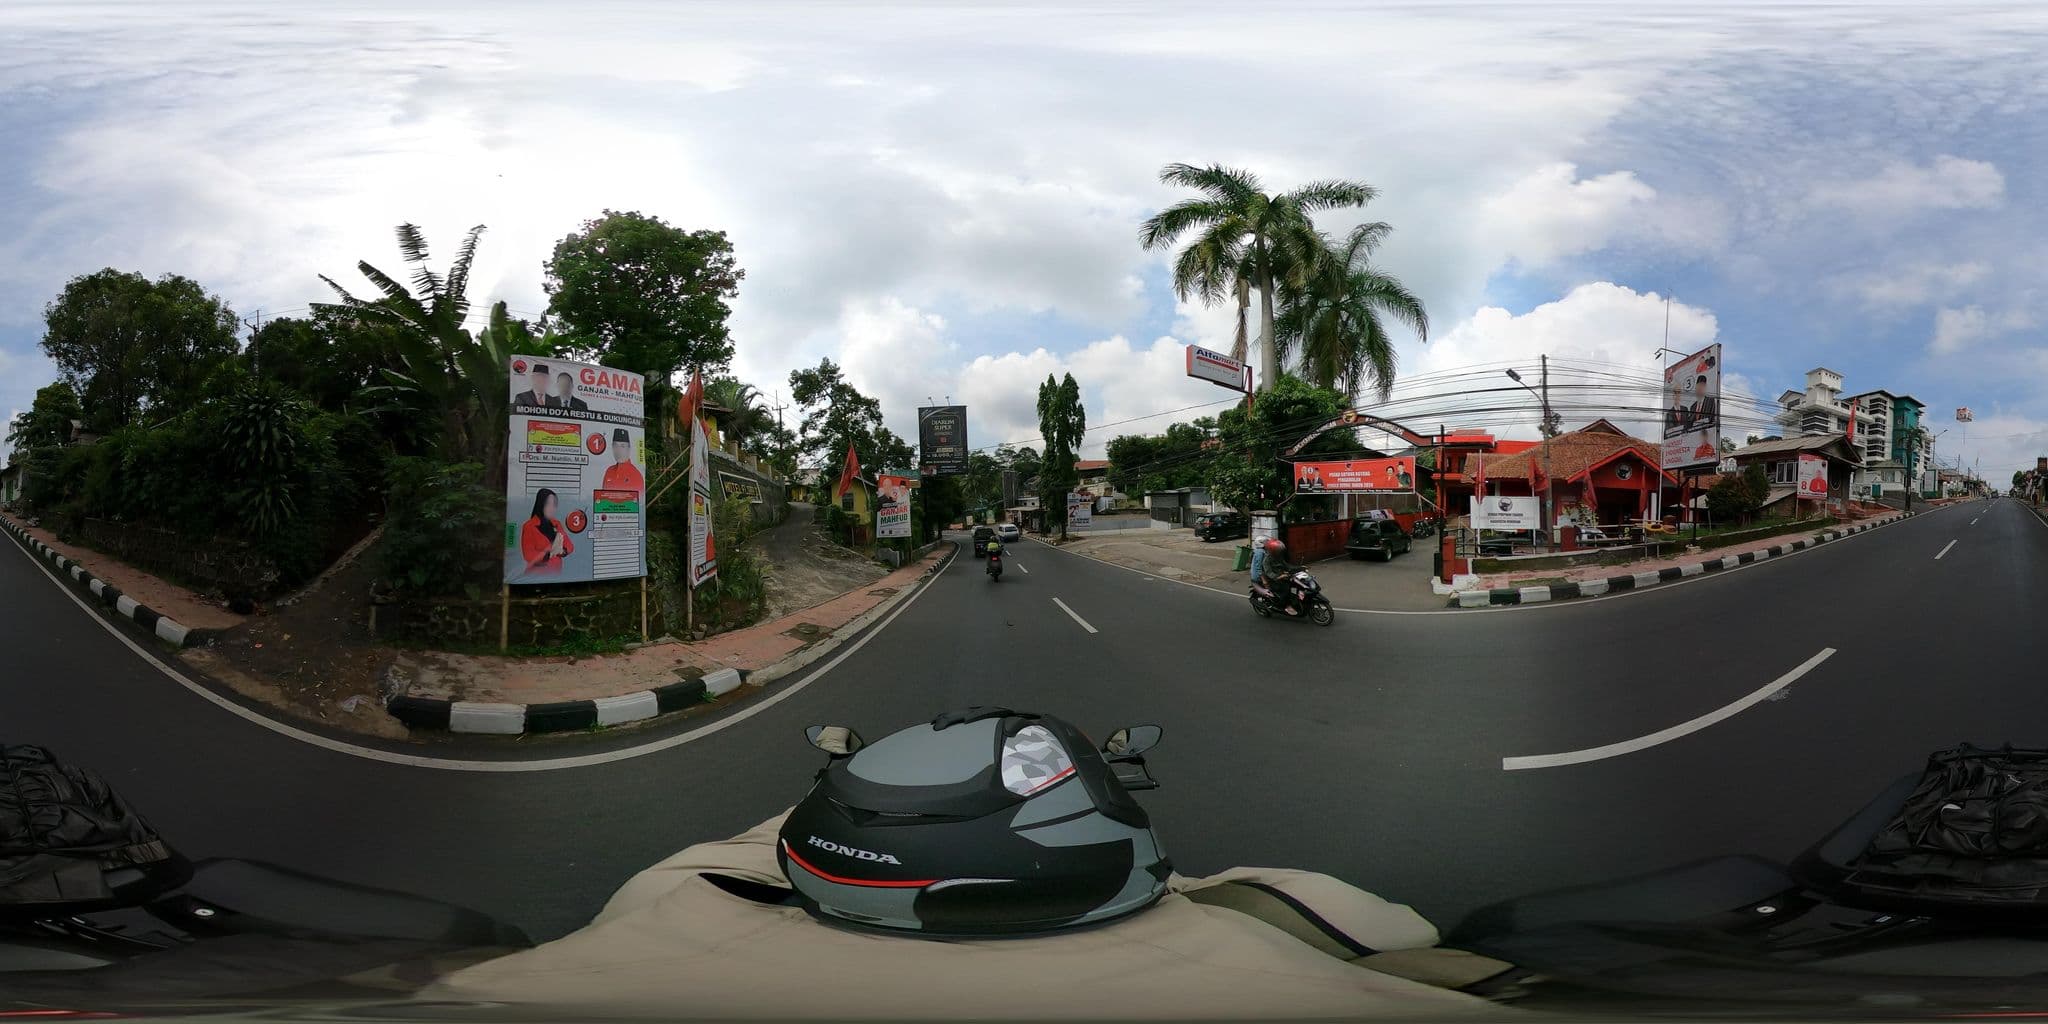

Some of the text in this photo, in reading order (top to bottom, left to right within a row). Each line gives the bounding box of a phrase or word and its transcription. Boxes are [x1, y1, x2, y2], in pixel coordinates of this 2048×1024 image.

[1196, 349, 1239, 367] Alfamart
[580, 368, 640, 394] GAMA
[578, 385, 609, 395] GANJAR
[616, 391, 642, 402] MAHFUD
[516, 406, 548, 415] MOHON
[549, 408, 569, 417] DO'A
[570, 411, 595, 419] RESTU
[604, 415, 641, 426] DUKUNGAN
[593, 438, 599, 450] 1
[1802, 481, 1807, 490] 8
[881, 506, 908, 516] GANJAR
[573, 516, 580, 526] 3
[880, 514, 908, 524] MAHFUD
[808, 836, 902, 864] HONDA
